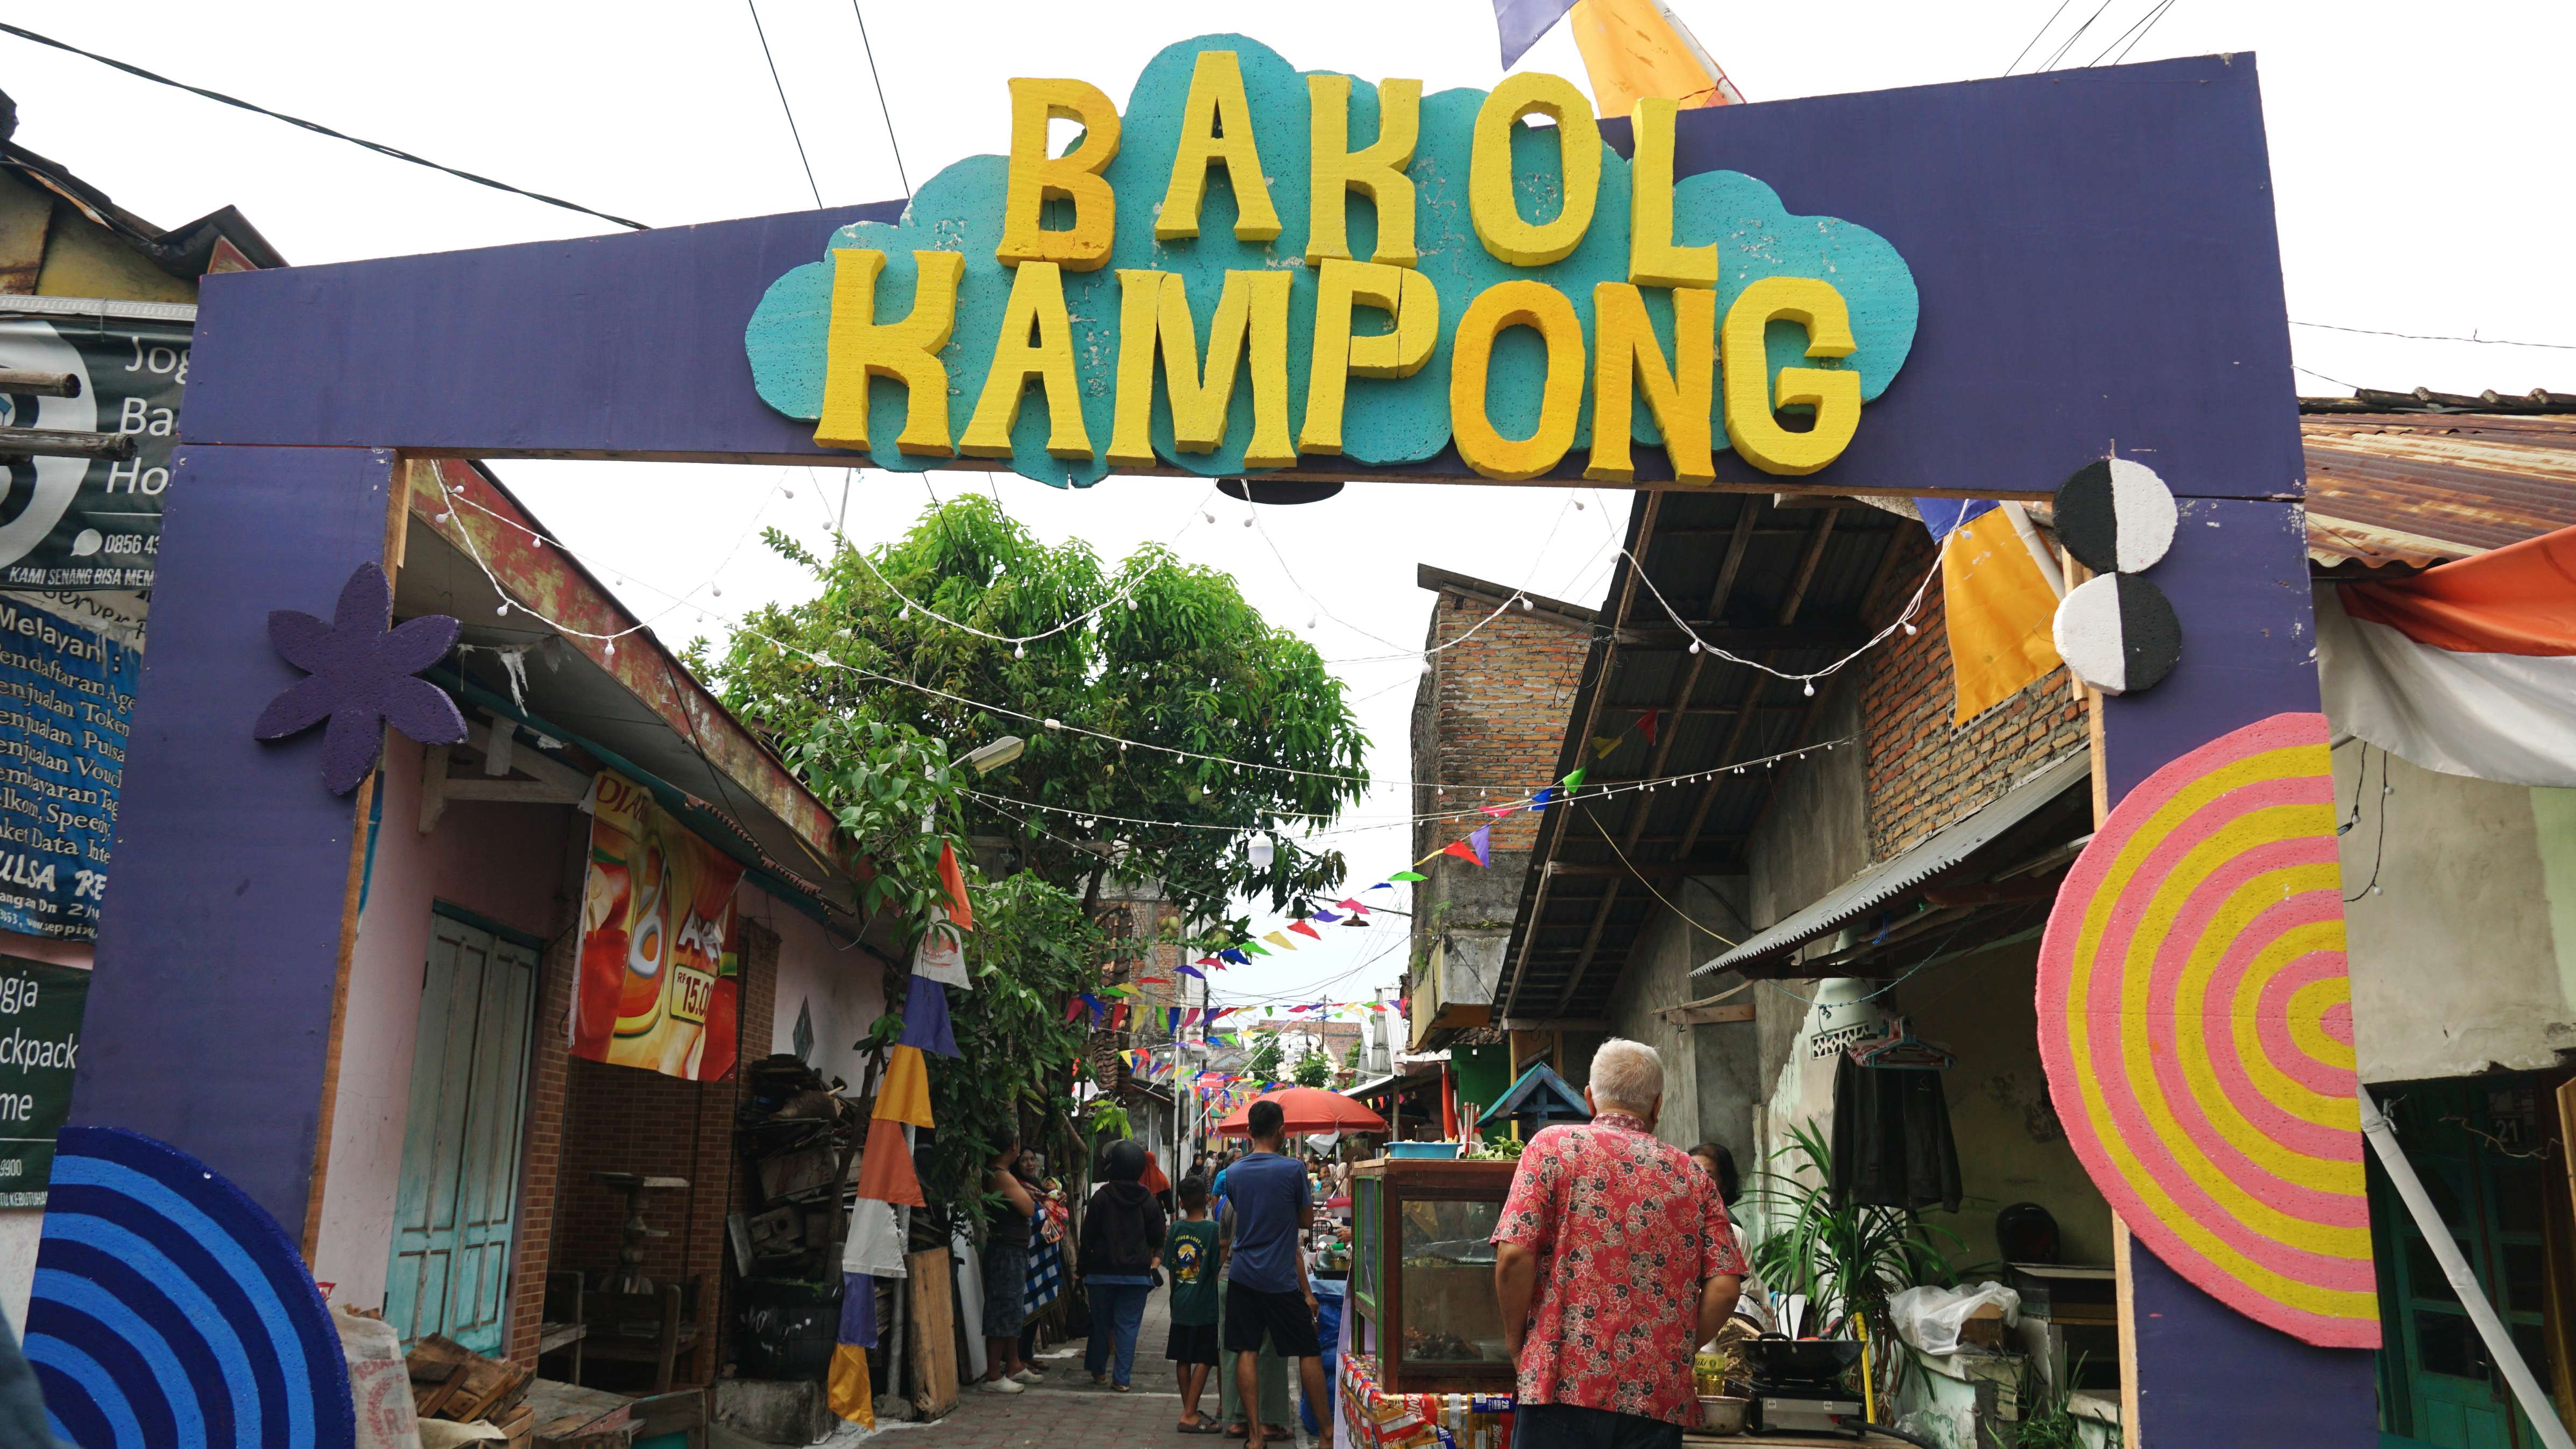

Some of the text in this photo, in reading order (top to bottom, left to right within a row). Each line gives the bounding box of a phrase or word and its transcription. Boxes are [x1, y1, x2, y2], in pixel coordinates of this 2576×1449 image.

[995, 50, 1718, 289] BAKOL
[812, 248, 1861, 485] KAMPONG
[119, 397, 179, 437] Ba
[107, 457, 169, 495] Ho
[104, 534, 143, 554] 0856
[9, 566, 46, 585] KAMI
[48, 568, 93, 585] SENANG
[94, 568, 121, 585] BISA
[81, 701, 130, 737] Token
[83, 730, 125, 762] Pulsa
[0, 787, 42, 823] lkom,
[32, 827, 79, 856] Data
[0, 850, 56, 892] ULSA
[0, 970, 38, 1014] gja
[0, 1027, 79, 1075] ckpack
[2495, 1119, 2518, 1142] 21
